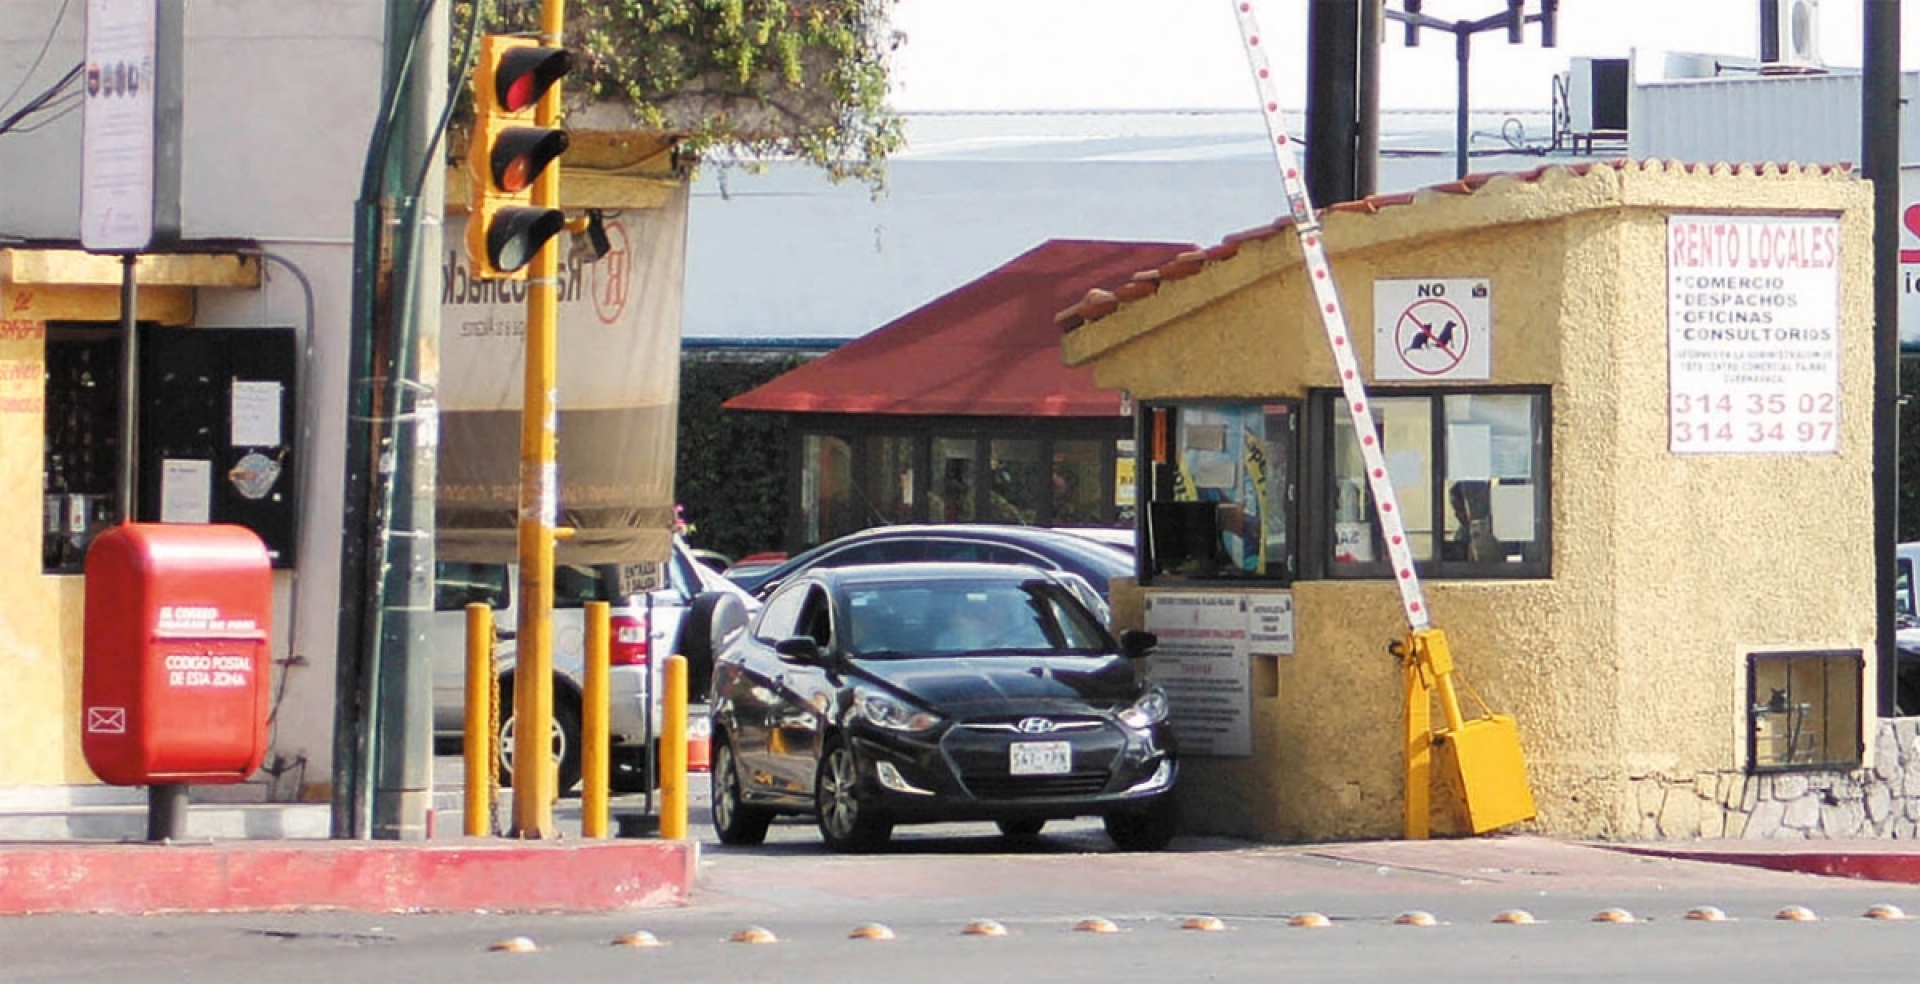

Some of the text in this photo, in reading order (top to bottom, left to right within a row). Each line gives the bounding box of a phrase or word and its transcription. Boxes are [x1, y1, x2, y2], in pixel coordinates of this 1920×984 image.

[1673, 223, 1835, 269] RENTO LOCALES
[1417, 283, 1446, 297] NO
[1674, 392, 1834, 414] 314 35 02
[1675, 421, 1834, 443] 314 34 97
